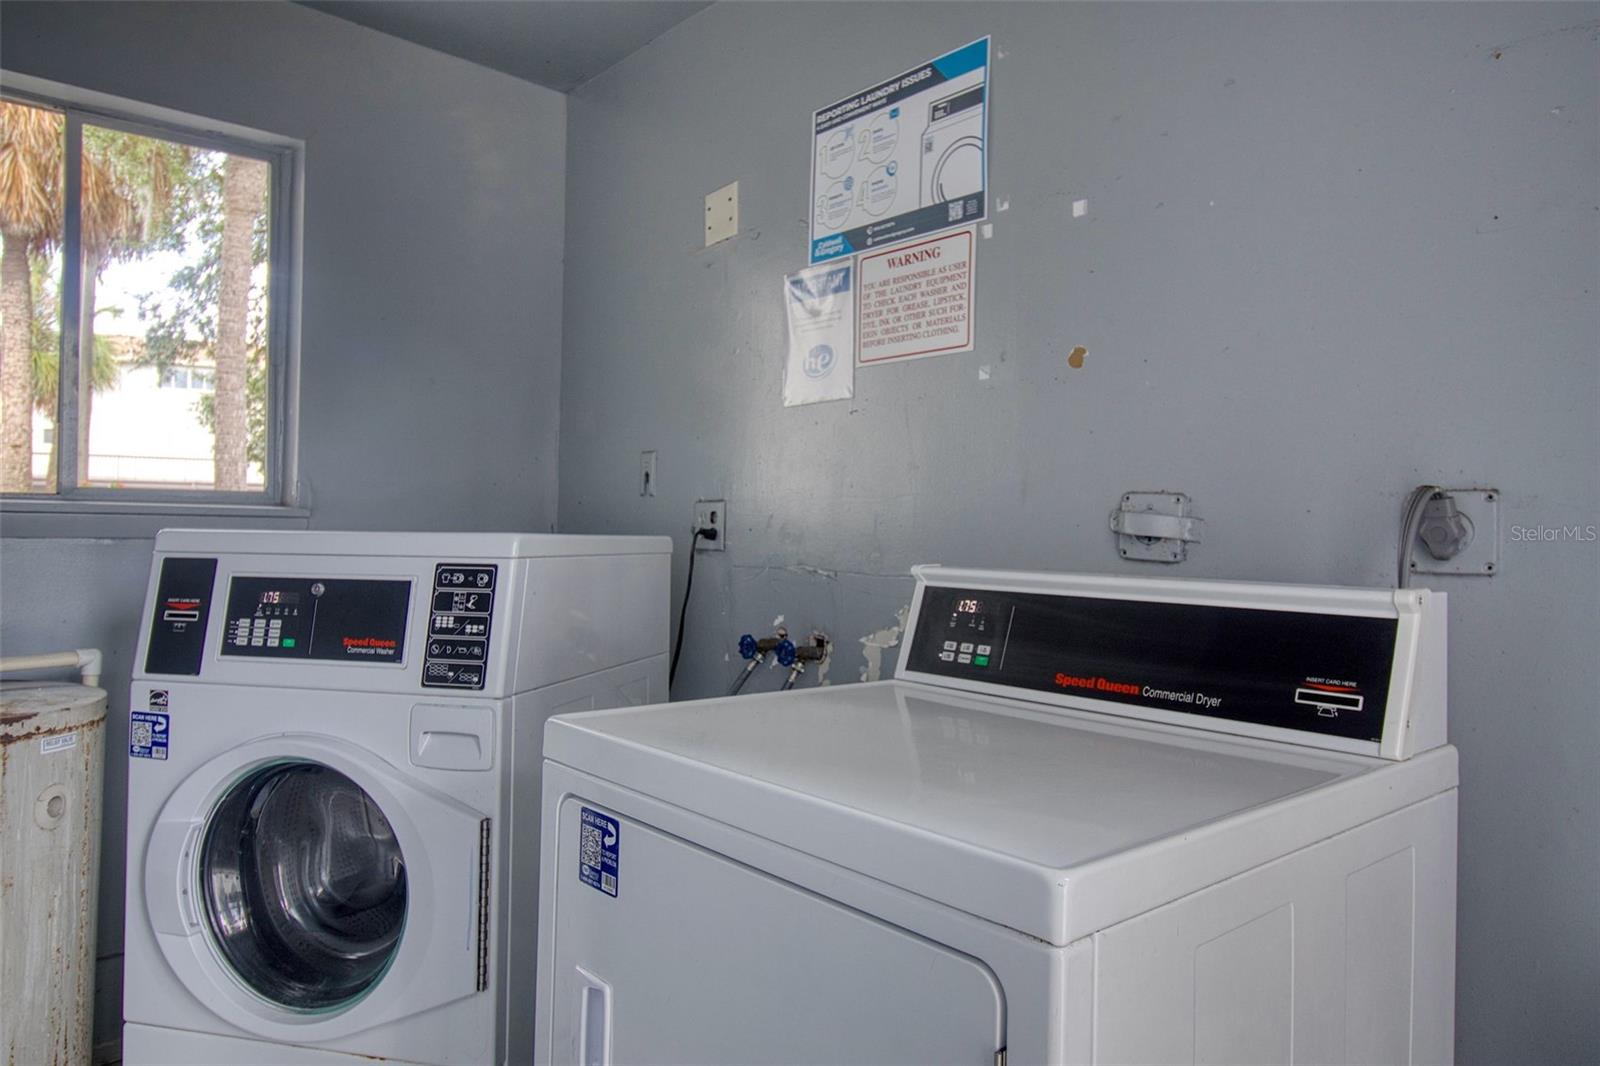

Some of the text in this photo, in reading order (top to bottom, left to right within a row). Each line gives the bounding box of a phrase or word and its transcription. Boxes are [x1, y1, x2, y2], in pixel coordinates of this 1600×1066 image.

[816, 67, 933, 124] REPORTING LAUNDRY ISSUES
[887, 246, 941, 269] WARNING
[863, 271, 968, 301] OF THE LAUNDRY EQUIPMENT
[864, 261, 968, 292] YOU ARE RESPONSIBLE AS USER
[863, 282, 967, 310] TO CHECK EACH WASHER AND
[863, 310, 884, 320] DRYER
[886, 306, 899, 316] FOR
[879, 317, 891, 326] INK
[892, 314, 902, 323] OR
[904, 310, 926, 321] OTHER
[928, 306, 948, 316] SUCH
[880, 324, 910, 336] OBJECTS
[912, 320, 922, 330] OR
[925, 313, 967, 328] MATERIALS
[863, 338, 886, 349] BEFORE
[887, 330, 922, 345] INSERTING
[343, 636, 397, 648] Speed Queen
[346, 646, 376, 654] Commercial
[1055, 672, 1222, 709] Speed Queen Commercial Dryer
[582, 811, 608, 830] SCAN HERE
